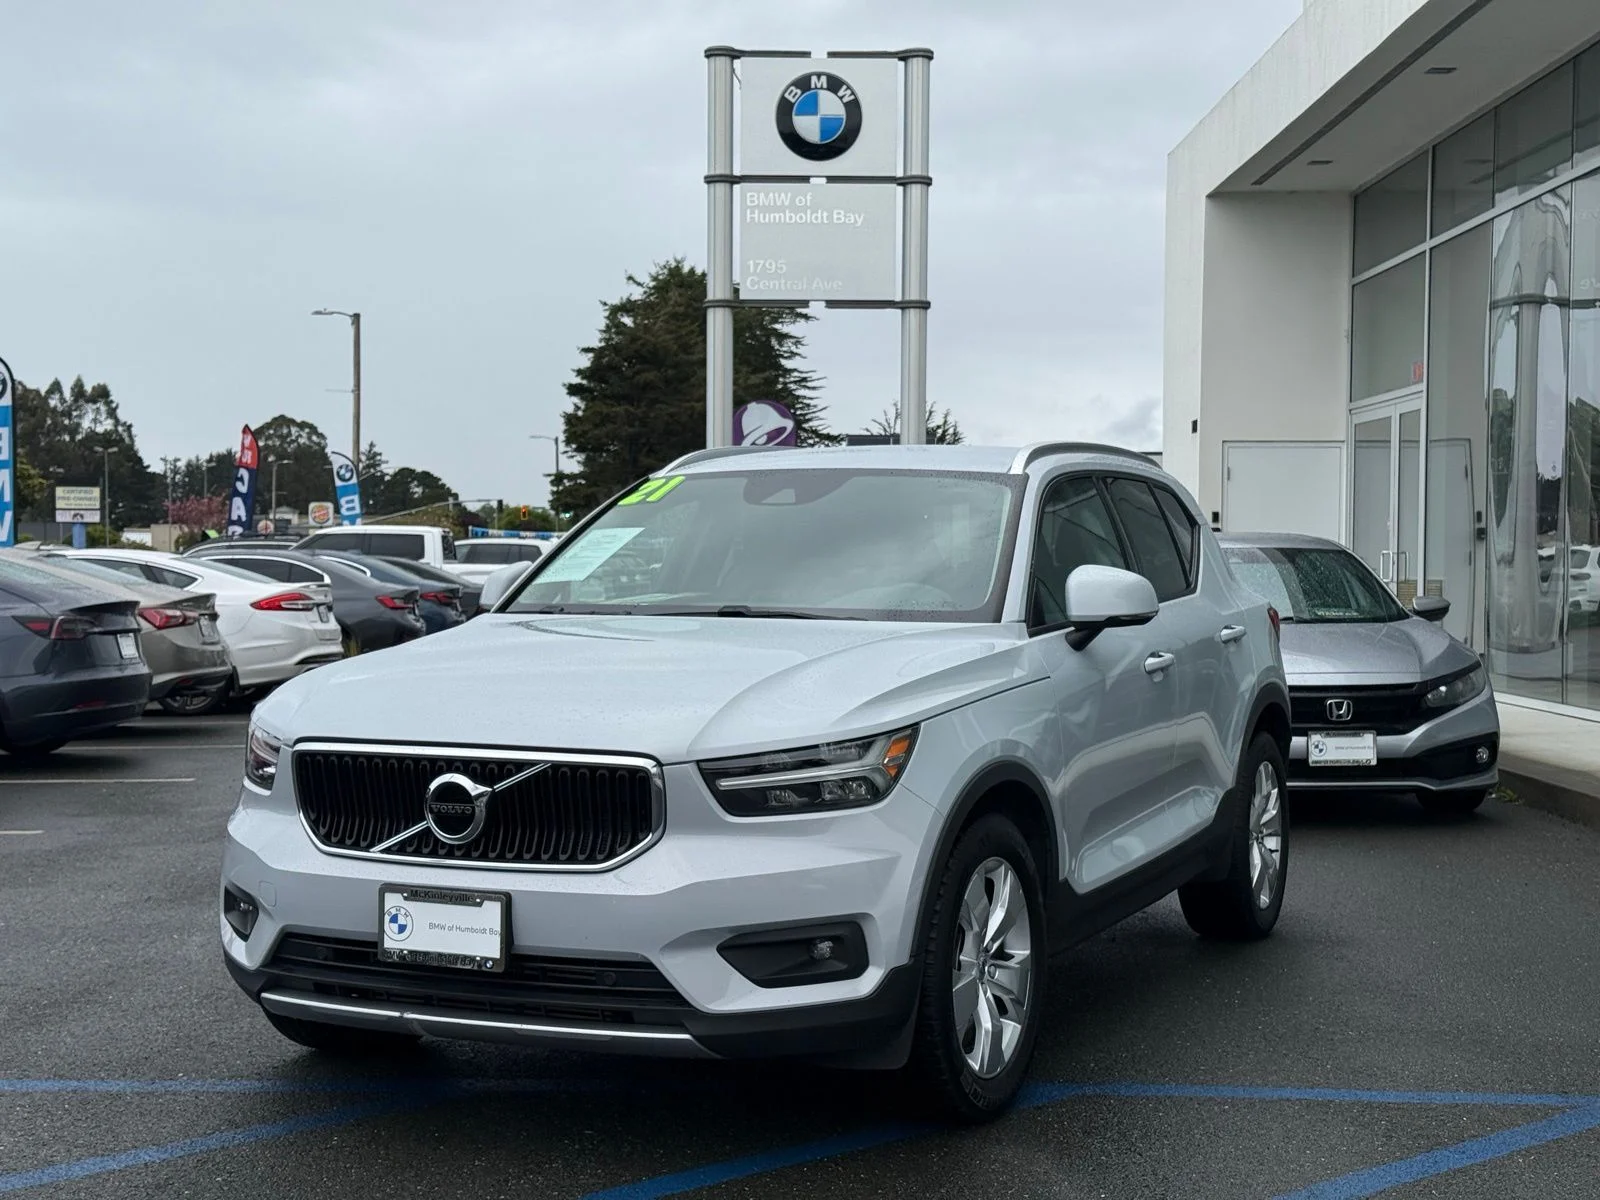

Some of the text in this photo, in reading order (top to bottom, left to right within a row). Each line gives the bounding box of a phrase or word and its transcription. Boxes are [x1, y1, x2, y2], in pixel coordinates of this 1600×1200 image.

[784, 75, 855, 104] BMW
[746, 192, 812, 206] BMW of
[746, 209, 864, 226] Humboldt Bay
[747, 259, 787, 274] 1795
[746, 276, 842, 290] Central Ave
[430, 804, 473, 815] VOLVO
[410, 889, 474, 903] McKinleyville
[428, 922, 447, 931] BMW
[447, 924, 454, 932] of
[455, 924, 487, 935] Humboldt
